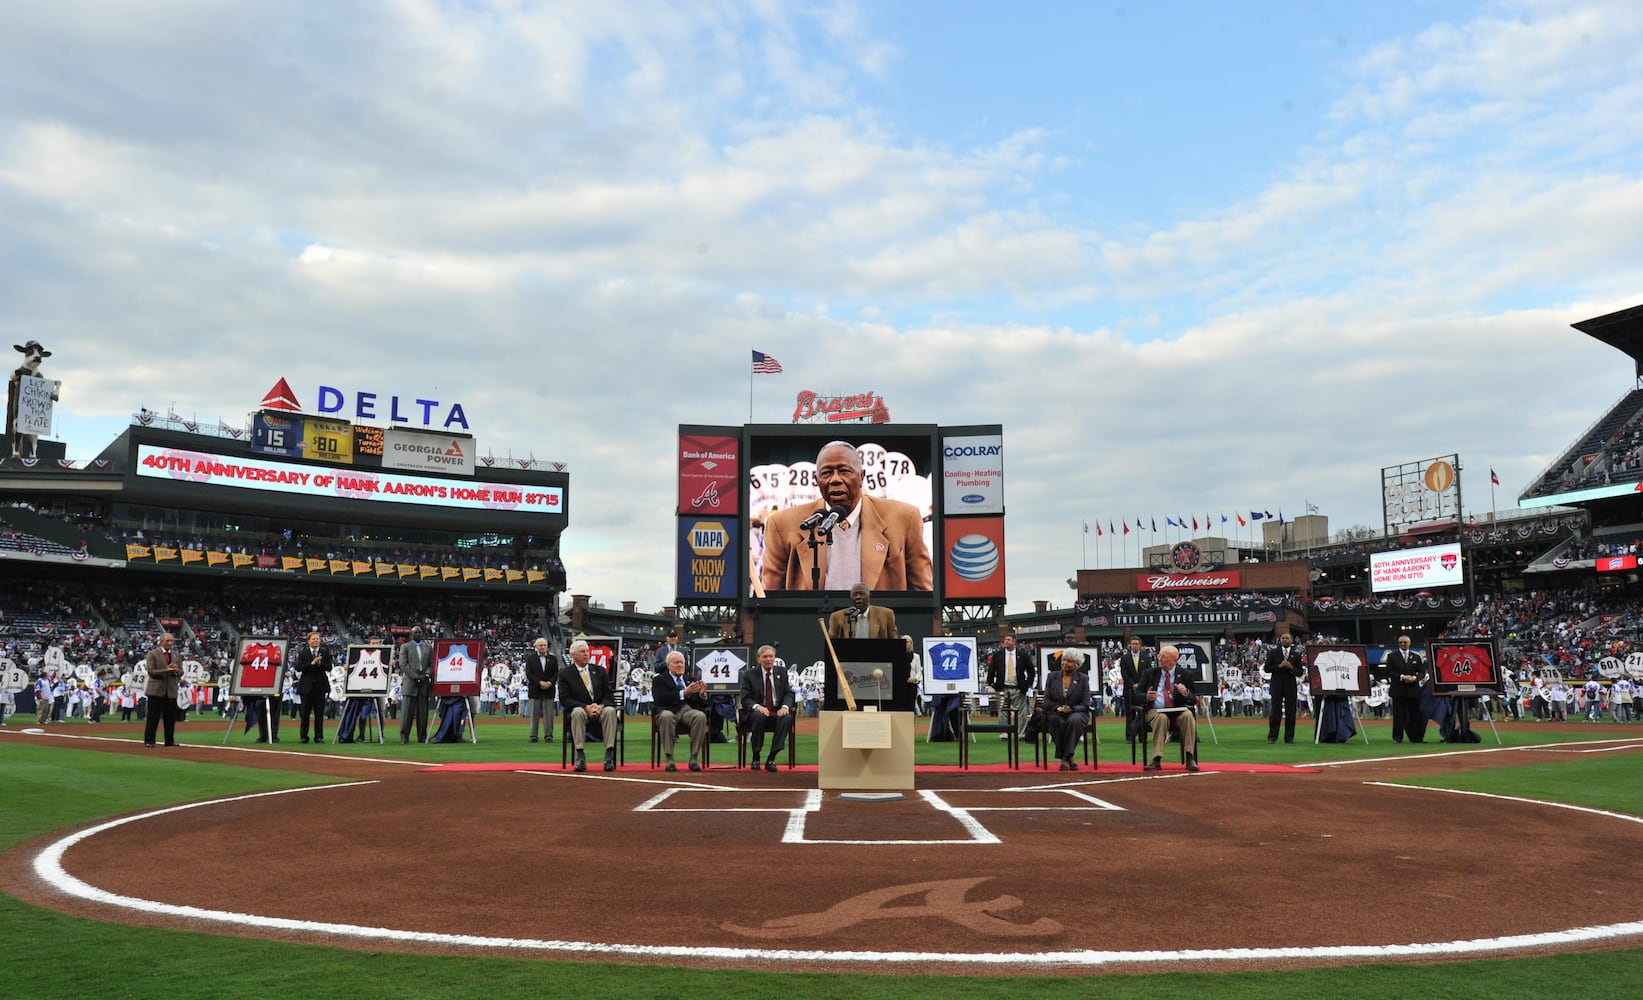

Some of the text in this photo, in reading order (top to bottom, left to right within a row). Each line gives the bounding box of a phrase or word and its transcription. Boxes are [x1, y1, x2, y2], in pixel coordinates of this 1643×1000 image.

[318, 386, 470, 430] DELTA
[792, 390, 874, 423] Braves
[394, 443, 442, 455] GEORGIA
[944, 446, 1001, 458] COOLRAY
[427, 455, 464, 466] POWER
[142, 454, 558, 506] 40TH ANNIVERSARY OF HANK AARON'S HOME RUN #715
[1384, 480, 1426, 500] GAS
[694, 531, 722, 548] NAPA
[692, 559, 726, 576] KNOW
[1392, 556, 1436, 567] ANNIVERSARY
[1383, 566, 1400, 574] HANK
[1402, 564, 1431, 573] AARON'S
[694, 576, 720, 593] HOW
[1146, 576, 1228, 590] Budweiser
[1116, 612, 1239, 624] THIS IS BRAVES COUNTRY
[251, 656, 269, 670] 44
[450, 657, 463, 666] 44
[942, 657, 958, 670] 44
[1177, 654, 1197, 669] 44
[1600, 660, 1619, 670] 601
[188, 664, 198, 672] 12
[358, 667, 378, 679] 44
[710, 664, 730, 678] 44
[804, 668, 817, 678] 211
[1452, 659, 1472, 678] 44
[1543, 669, 1558, 678] 576
[13, 672, 19, 682] 3
